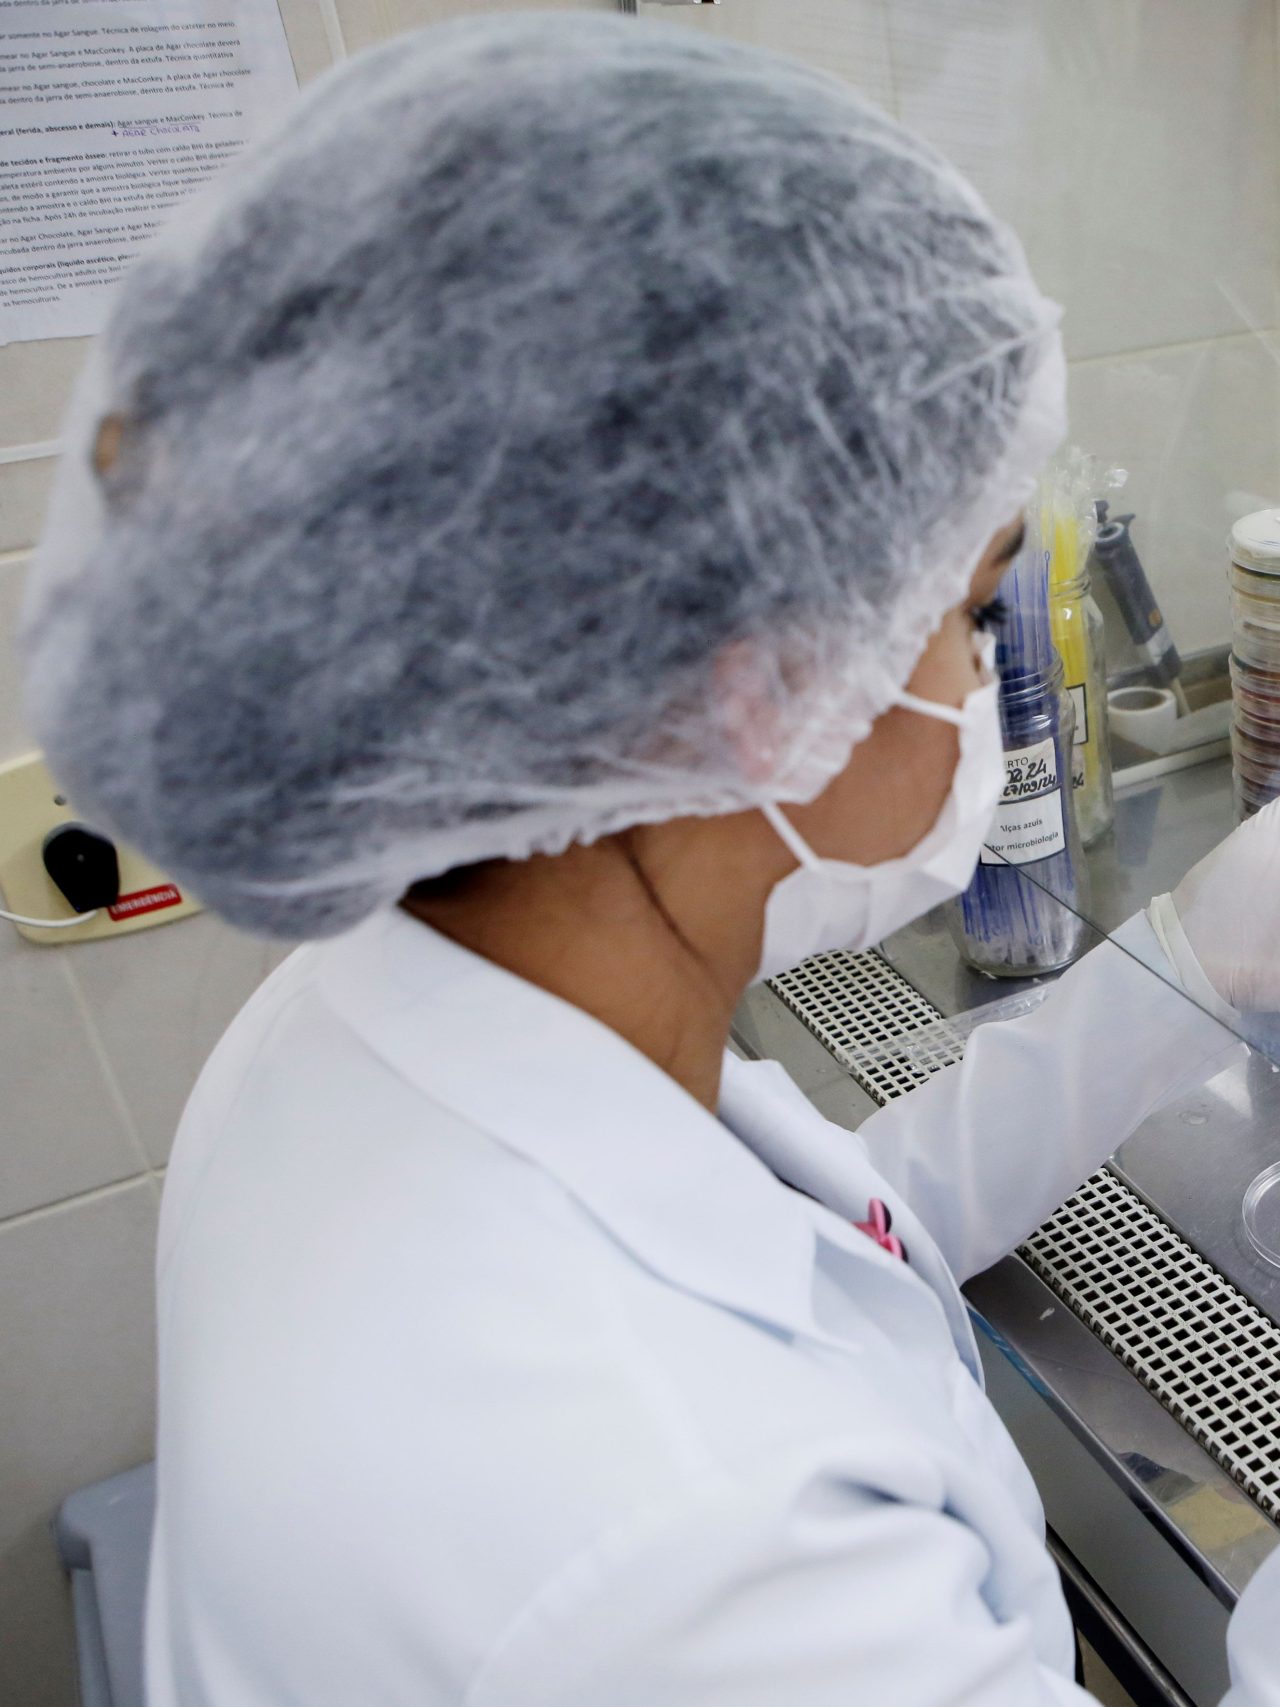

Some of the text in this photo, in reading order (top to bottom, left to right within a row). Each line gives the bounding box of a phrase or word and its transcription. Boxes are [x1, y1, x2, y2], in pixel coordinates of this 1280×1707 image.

[1004, 757, 1029, 769] RTO
[1023, 818, 1043, 829] azuis
[1007, 832, 1059, 851] microbiologia
